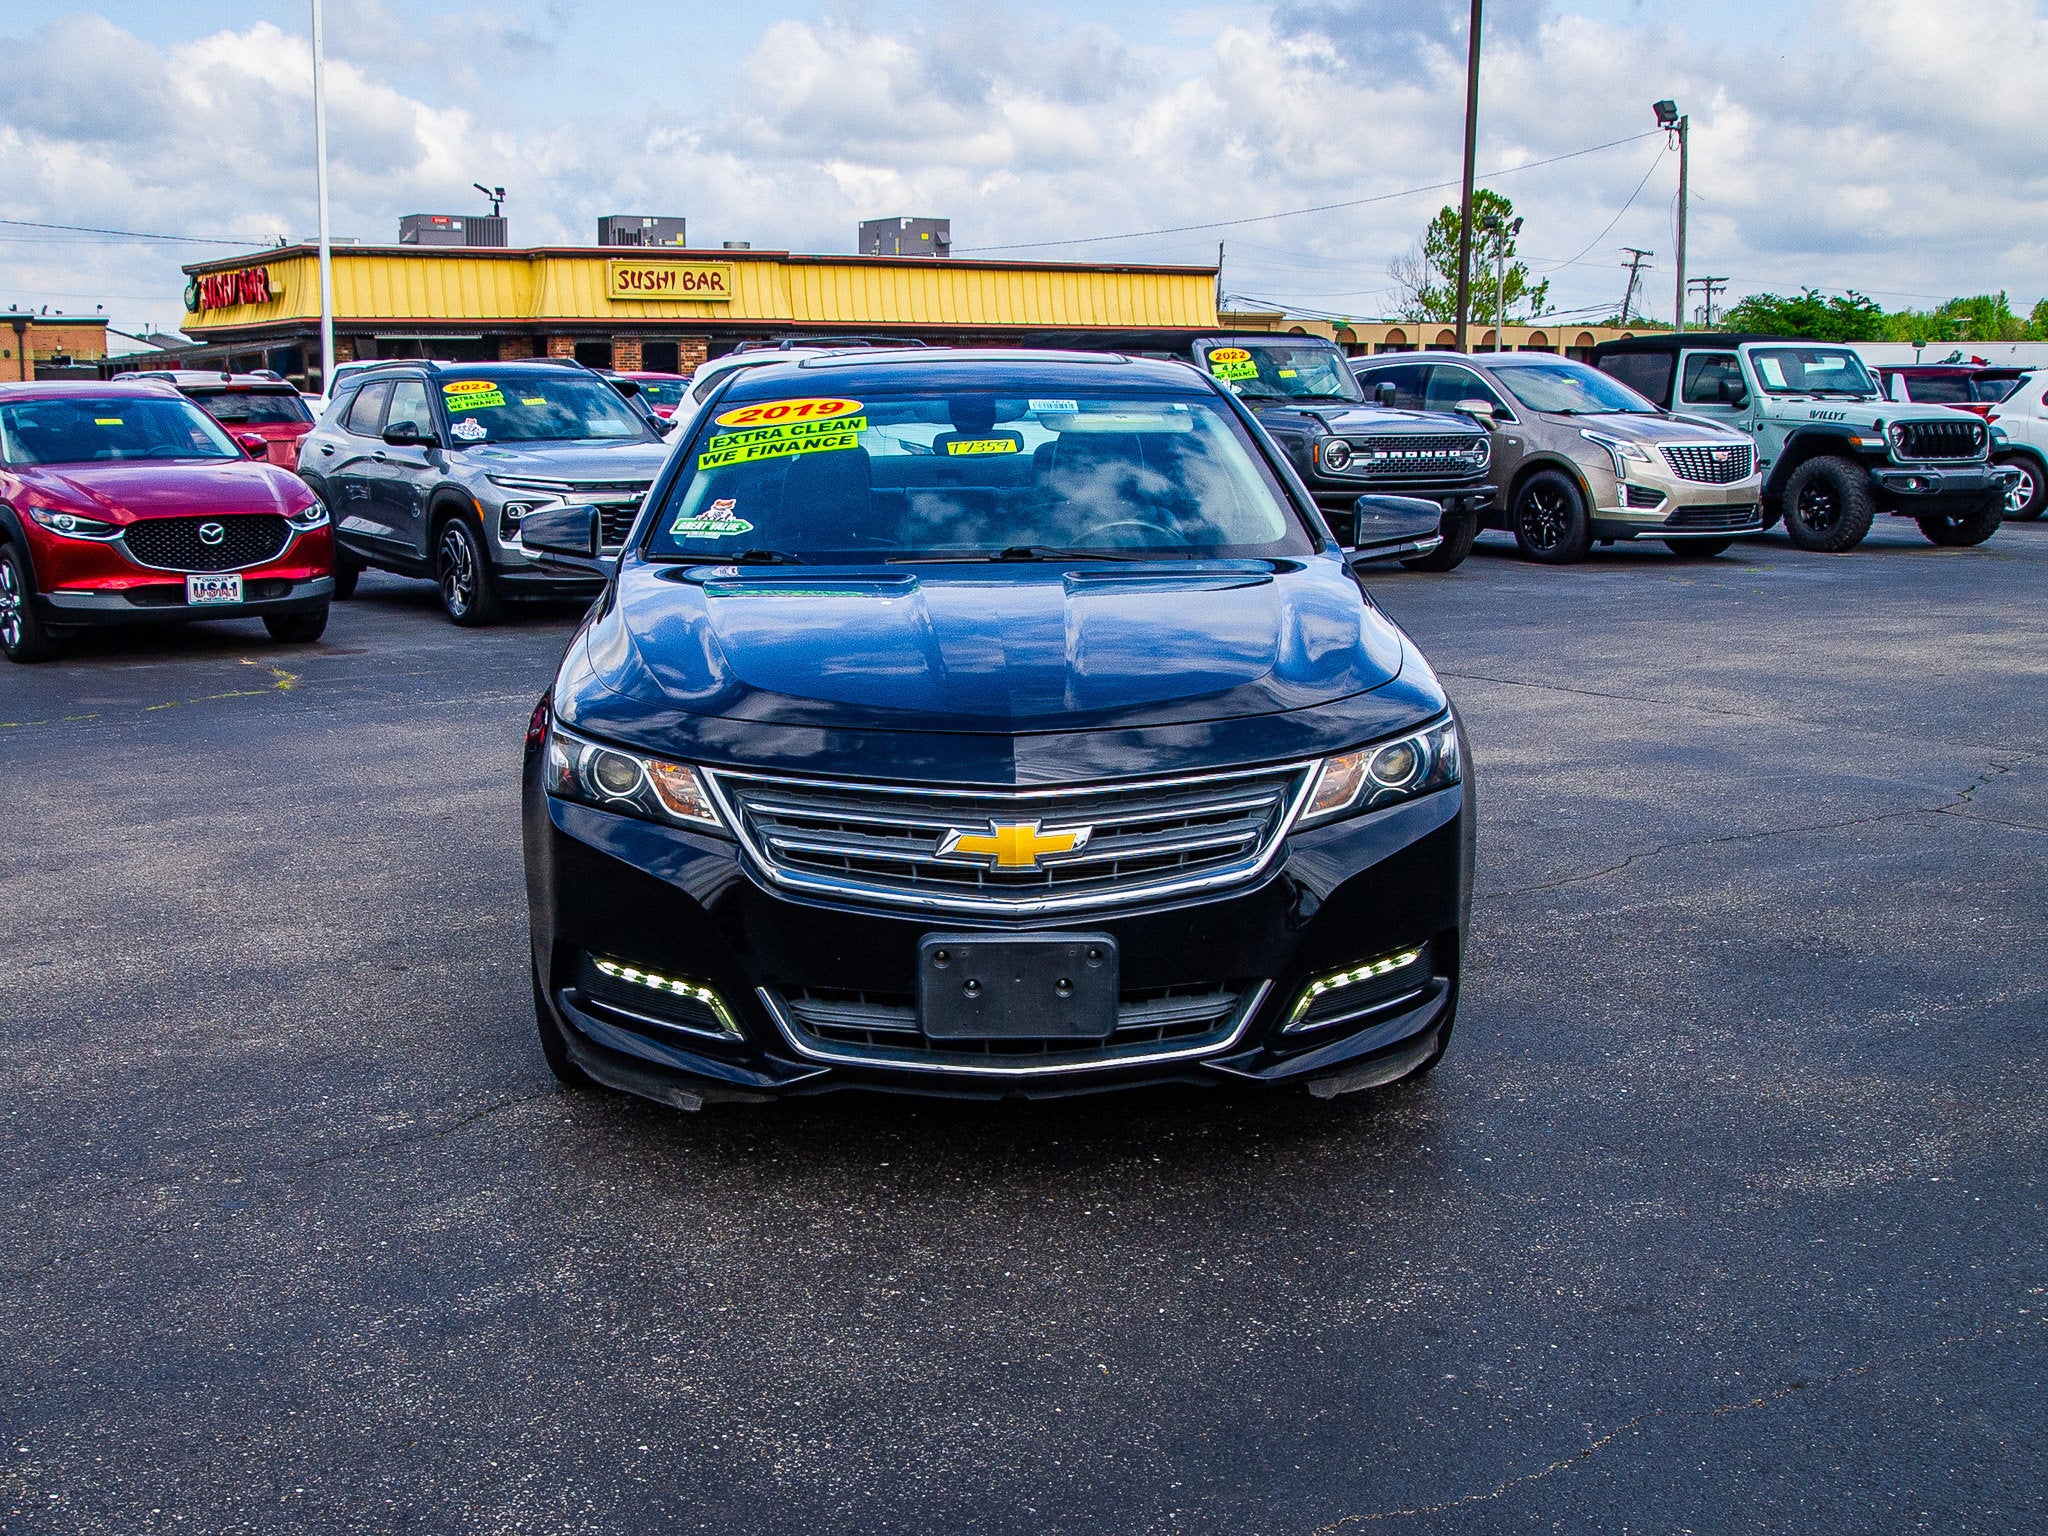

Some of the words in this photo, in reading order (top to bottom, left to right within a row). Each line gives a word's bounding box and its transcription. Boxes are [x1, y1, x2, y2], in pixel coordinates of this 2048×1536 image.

[618, 269, 675, 290] SUSHI
[683, 271, 725, 290] BAR
[1216, 351, 1246, 361] 2022
[452, 384, 491, 392] 2024
[449, 395, 474, 404] EXTRA
[476, 391, 501, 399] CLEAN
[466, 399, 502, 407] FINANCE
[732, 401, 844, 424] 2019
[1809, 409, 1847, 421] WILLYS
[712, 428, 784, 449] EXTRA
[790, 418, 861, 436] CLEAN
[702, 450, 737, 466] WE
[746, 435, 853, 457] FINANCE
[1374, 450, 1461, 459] BRONCO
[677, 521, 708, 531] GREAT
[709, 522, 739, 532] VALUE
